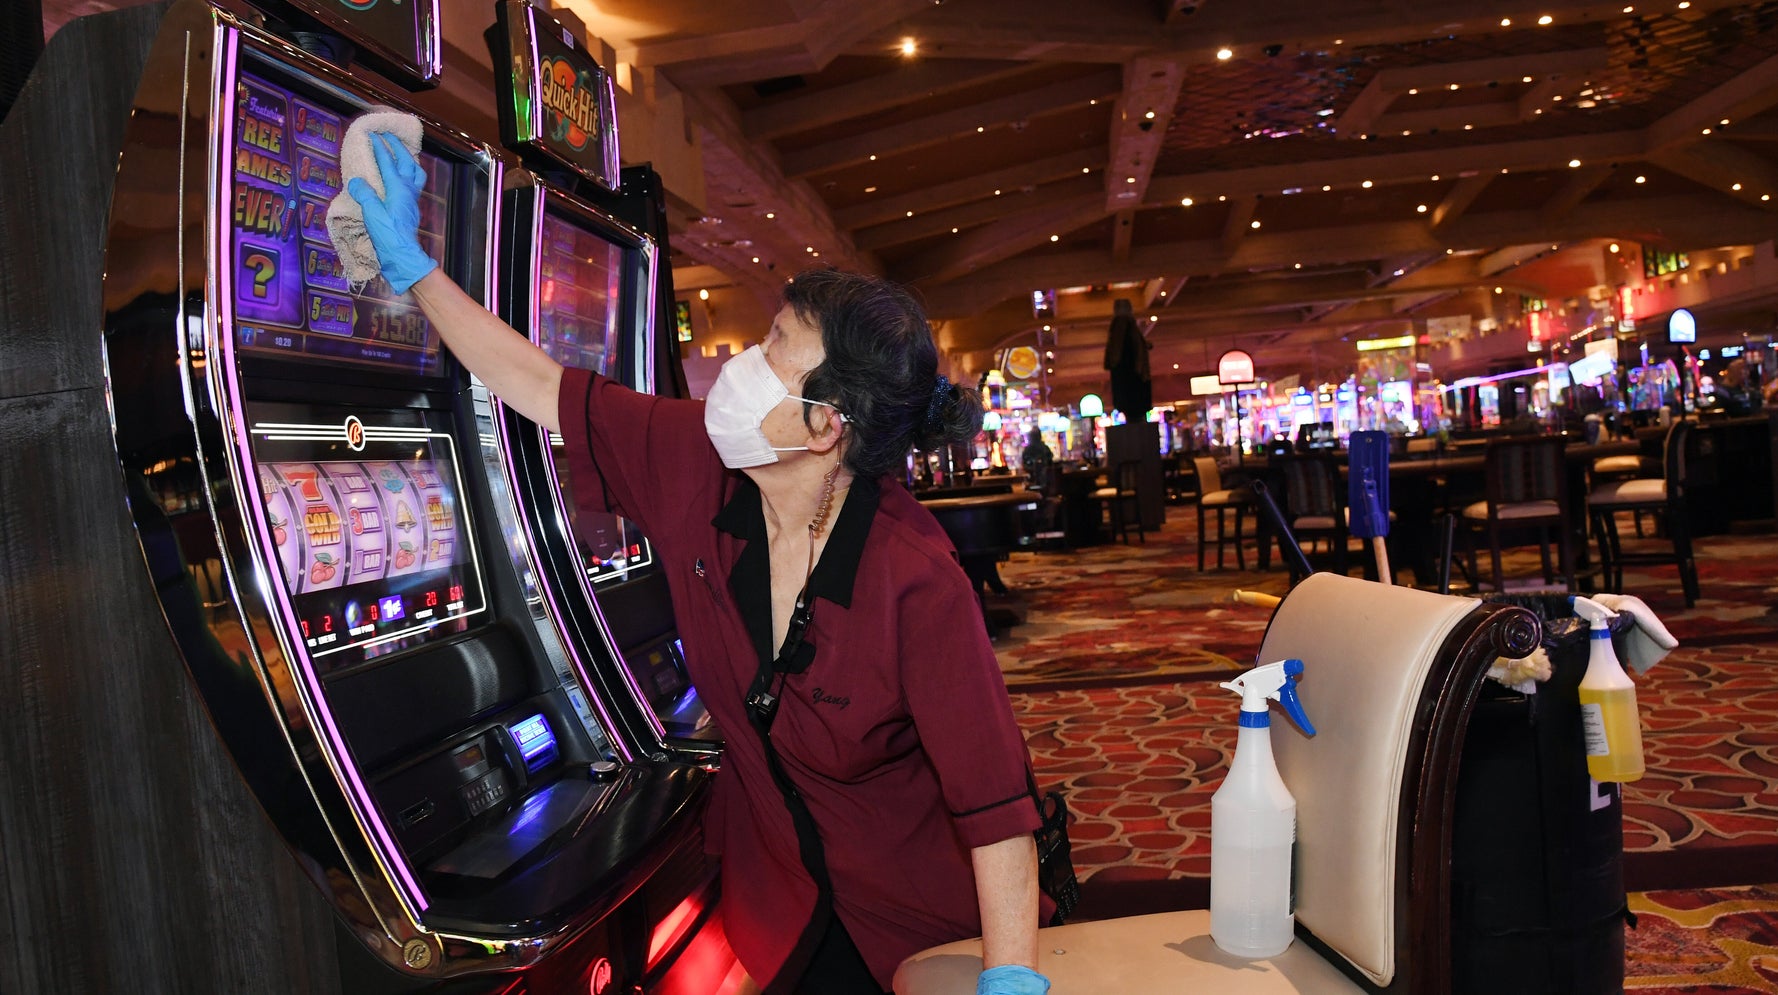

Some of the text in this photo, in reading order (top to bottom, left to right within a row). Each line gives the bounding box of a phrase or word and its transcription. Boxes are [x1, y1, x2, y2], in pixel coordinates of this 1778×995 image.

[541, 60, 598, 136] Quick Hit
[296, 107, 307, 133] 9
[236, 149, 291, 186] AMES
[301, 157, 311, 181] 8
[304, 203, 315, 228] 7
[308, 250, 318, 275] 6
[311, 296, 322, 321] 5
[284, 471, 323, 501] 7
[350, 507, 380, 535] 3 BAR
[310, 532, 341, 547] WILD
[364, 553, 381, 569] BAR
[383, 599, 402, 618] 1¢
[426, 591, 437, 607] 20
[324, 615, 332, 632] 2
[371, 605, 378, 620] 0
[812, 687, 851, 711] Yang
